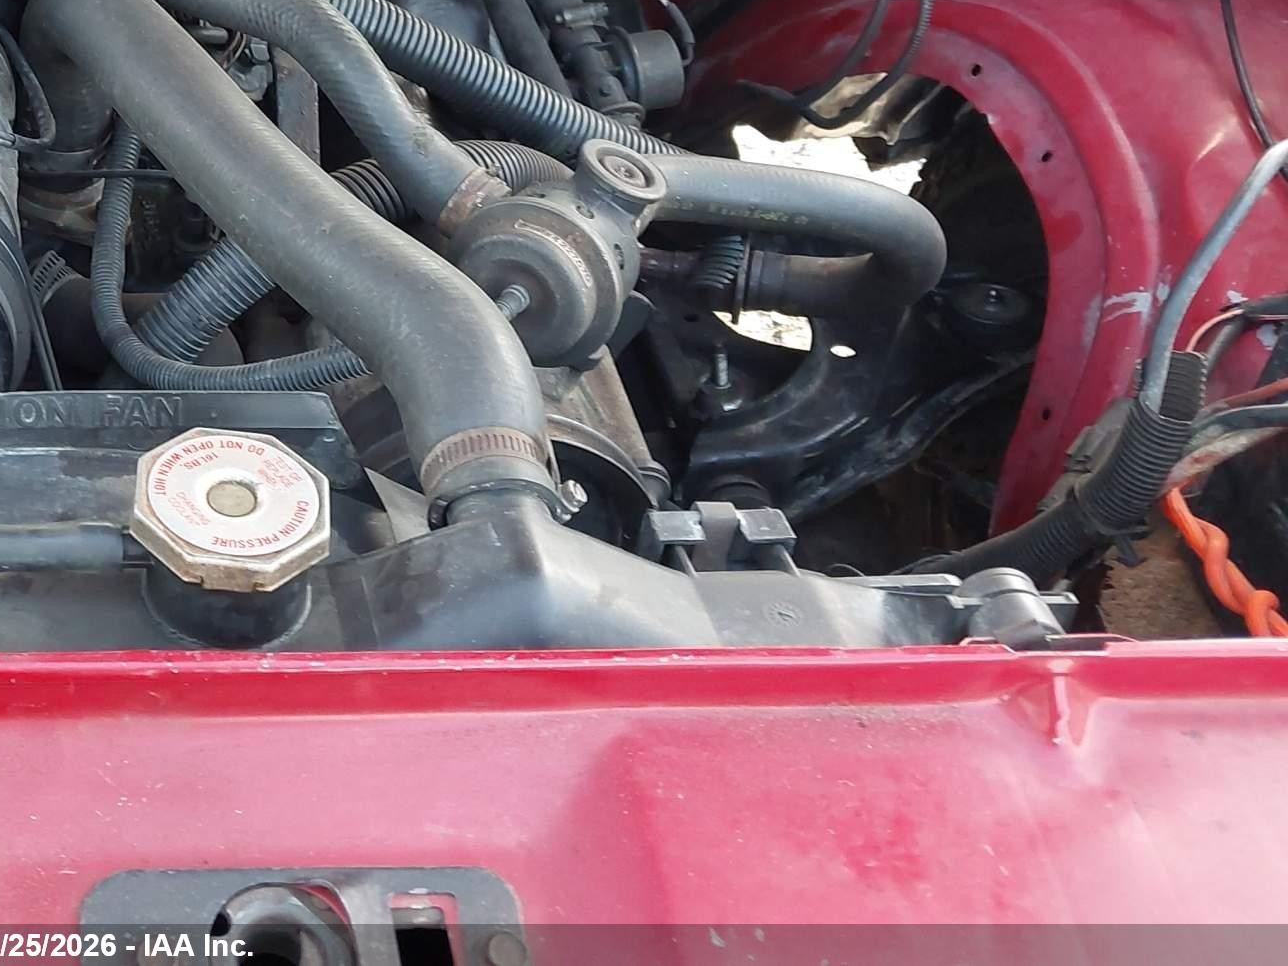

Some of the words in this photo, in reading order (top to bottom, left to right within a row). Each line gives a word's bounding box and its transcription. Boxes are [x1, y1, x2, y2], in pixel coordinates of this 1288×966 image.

[105, 394, 184, 429] FAN
[182, 440, 214, 456] OPEN
[219, 439, 243, 451] NOT
[247, 444, 266, 457] DO
[156, 453, 185, 482] WHEN
[153, 479, 168, 497] HOT
[277, 500, 310, 536] CAUTION
[211, 533, 281, 549] PRESSURE
